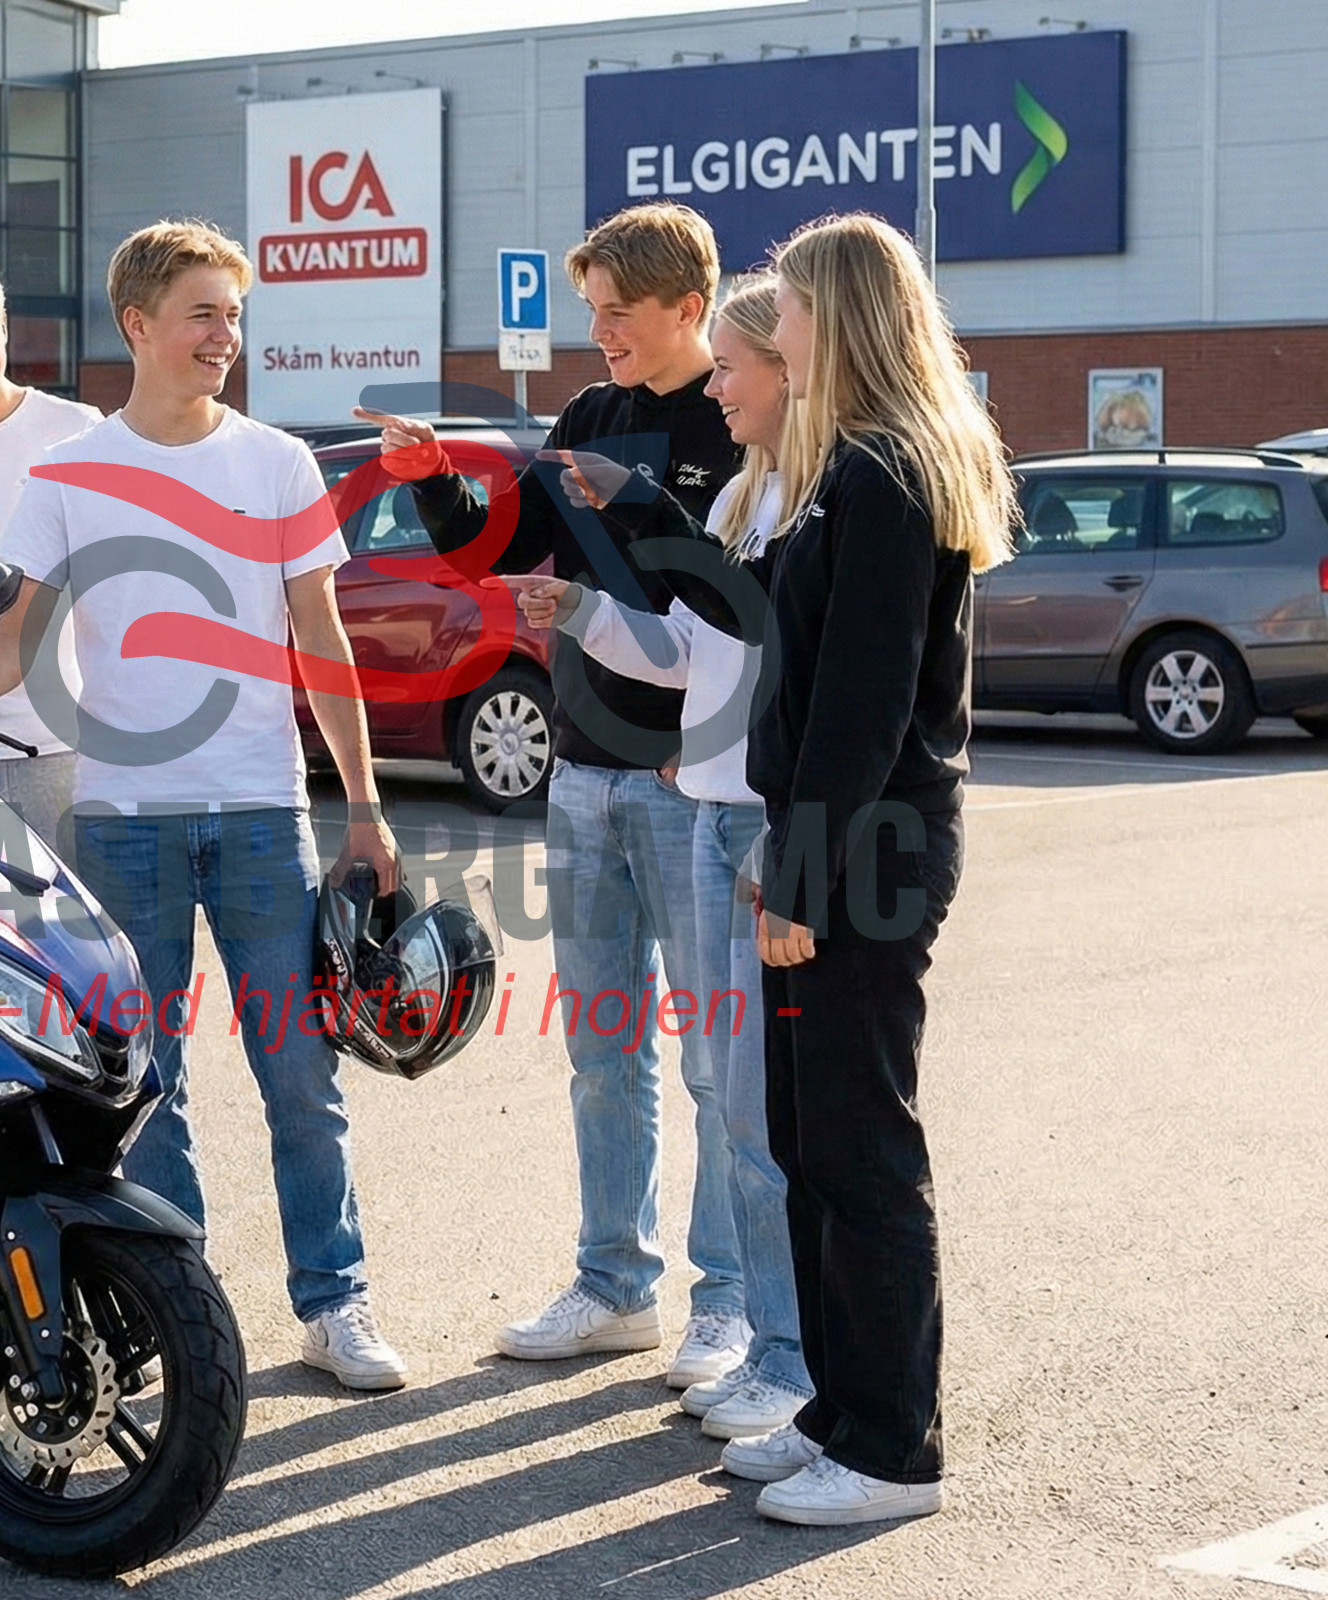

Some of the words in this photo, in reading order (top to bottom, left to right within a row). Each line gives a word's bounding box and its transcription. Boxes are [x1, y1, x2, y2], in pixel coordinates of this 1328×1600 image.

[289, 150, 394, 223] ICA
[627, 122, 1001, 196] ELGIGANTEN
[265, 237, 419, 273] KVANTUM
[510, 260, 539, 322] P
